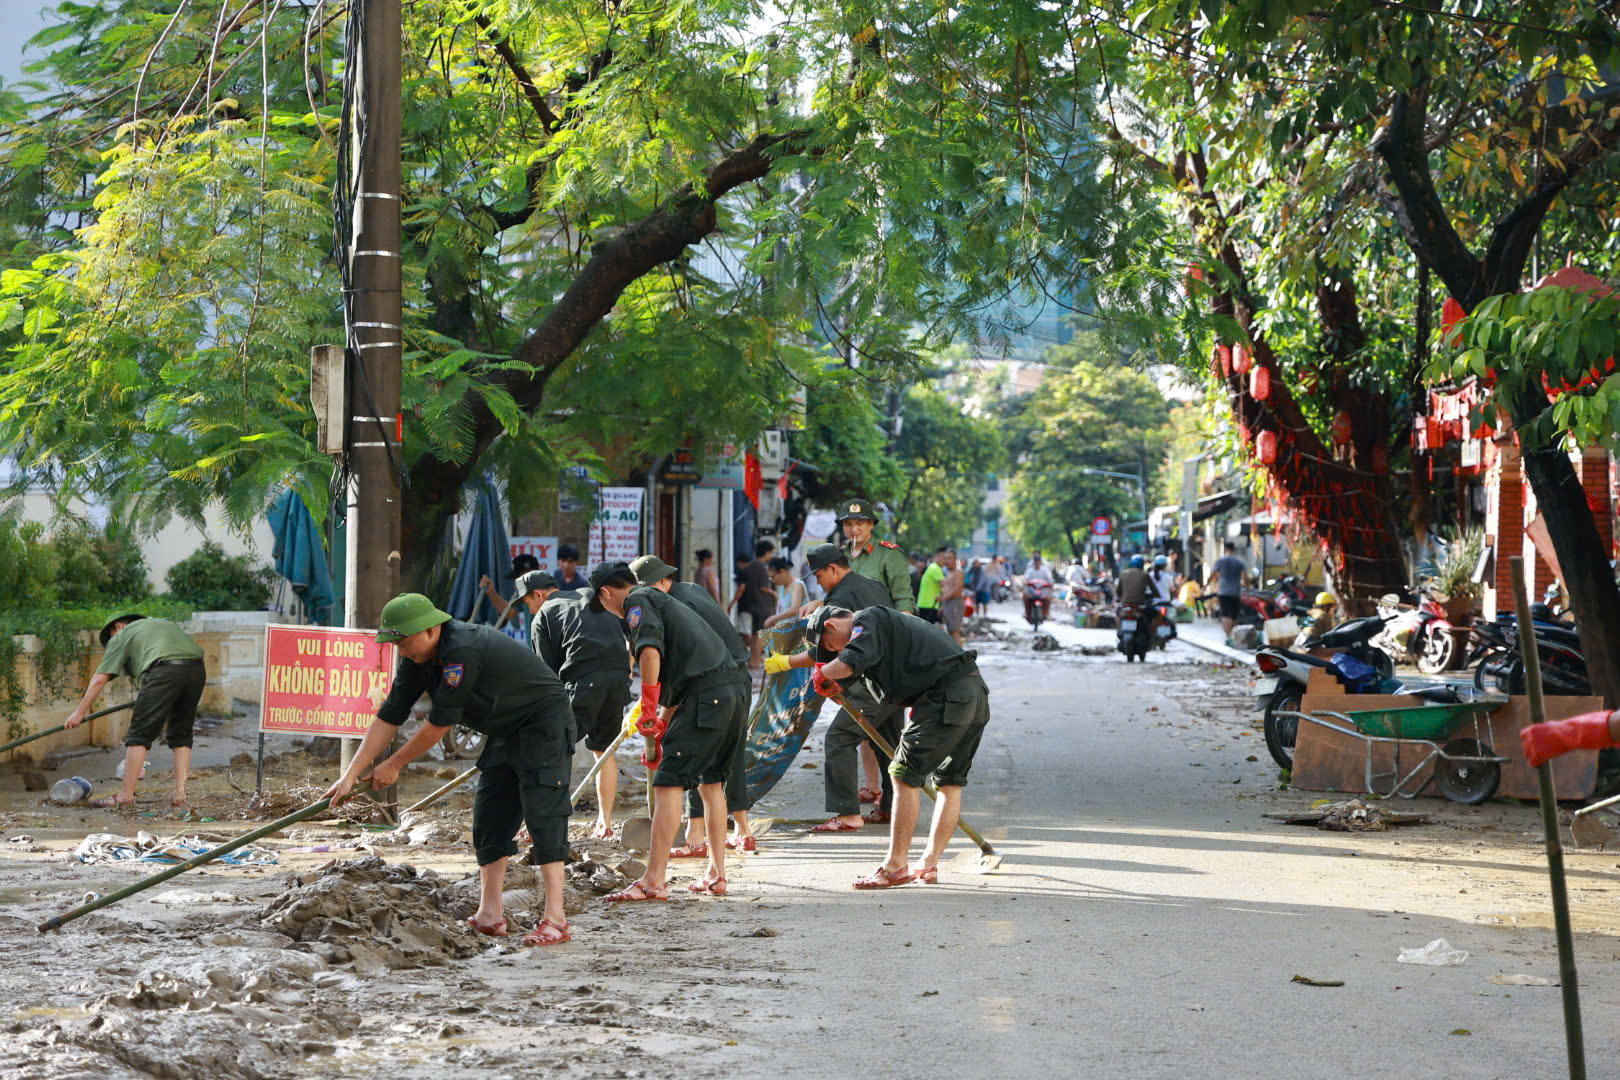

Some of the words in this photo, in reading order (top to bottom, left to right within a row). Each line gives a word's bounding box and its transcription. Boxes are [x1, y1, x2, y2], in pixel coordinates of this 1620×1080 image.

[297, 638, 321, 655] VUI
[325, 636, 364, 658] LÒNG
[269, 660, 325, 695] KHÔNG
[329, 664, 363, 704] ĐẬU
[366, 671, 388, 701] XE
[270, 705, 303, 724] TRƯỚC
[338, 711, 353, 727] CƠ
